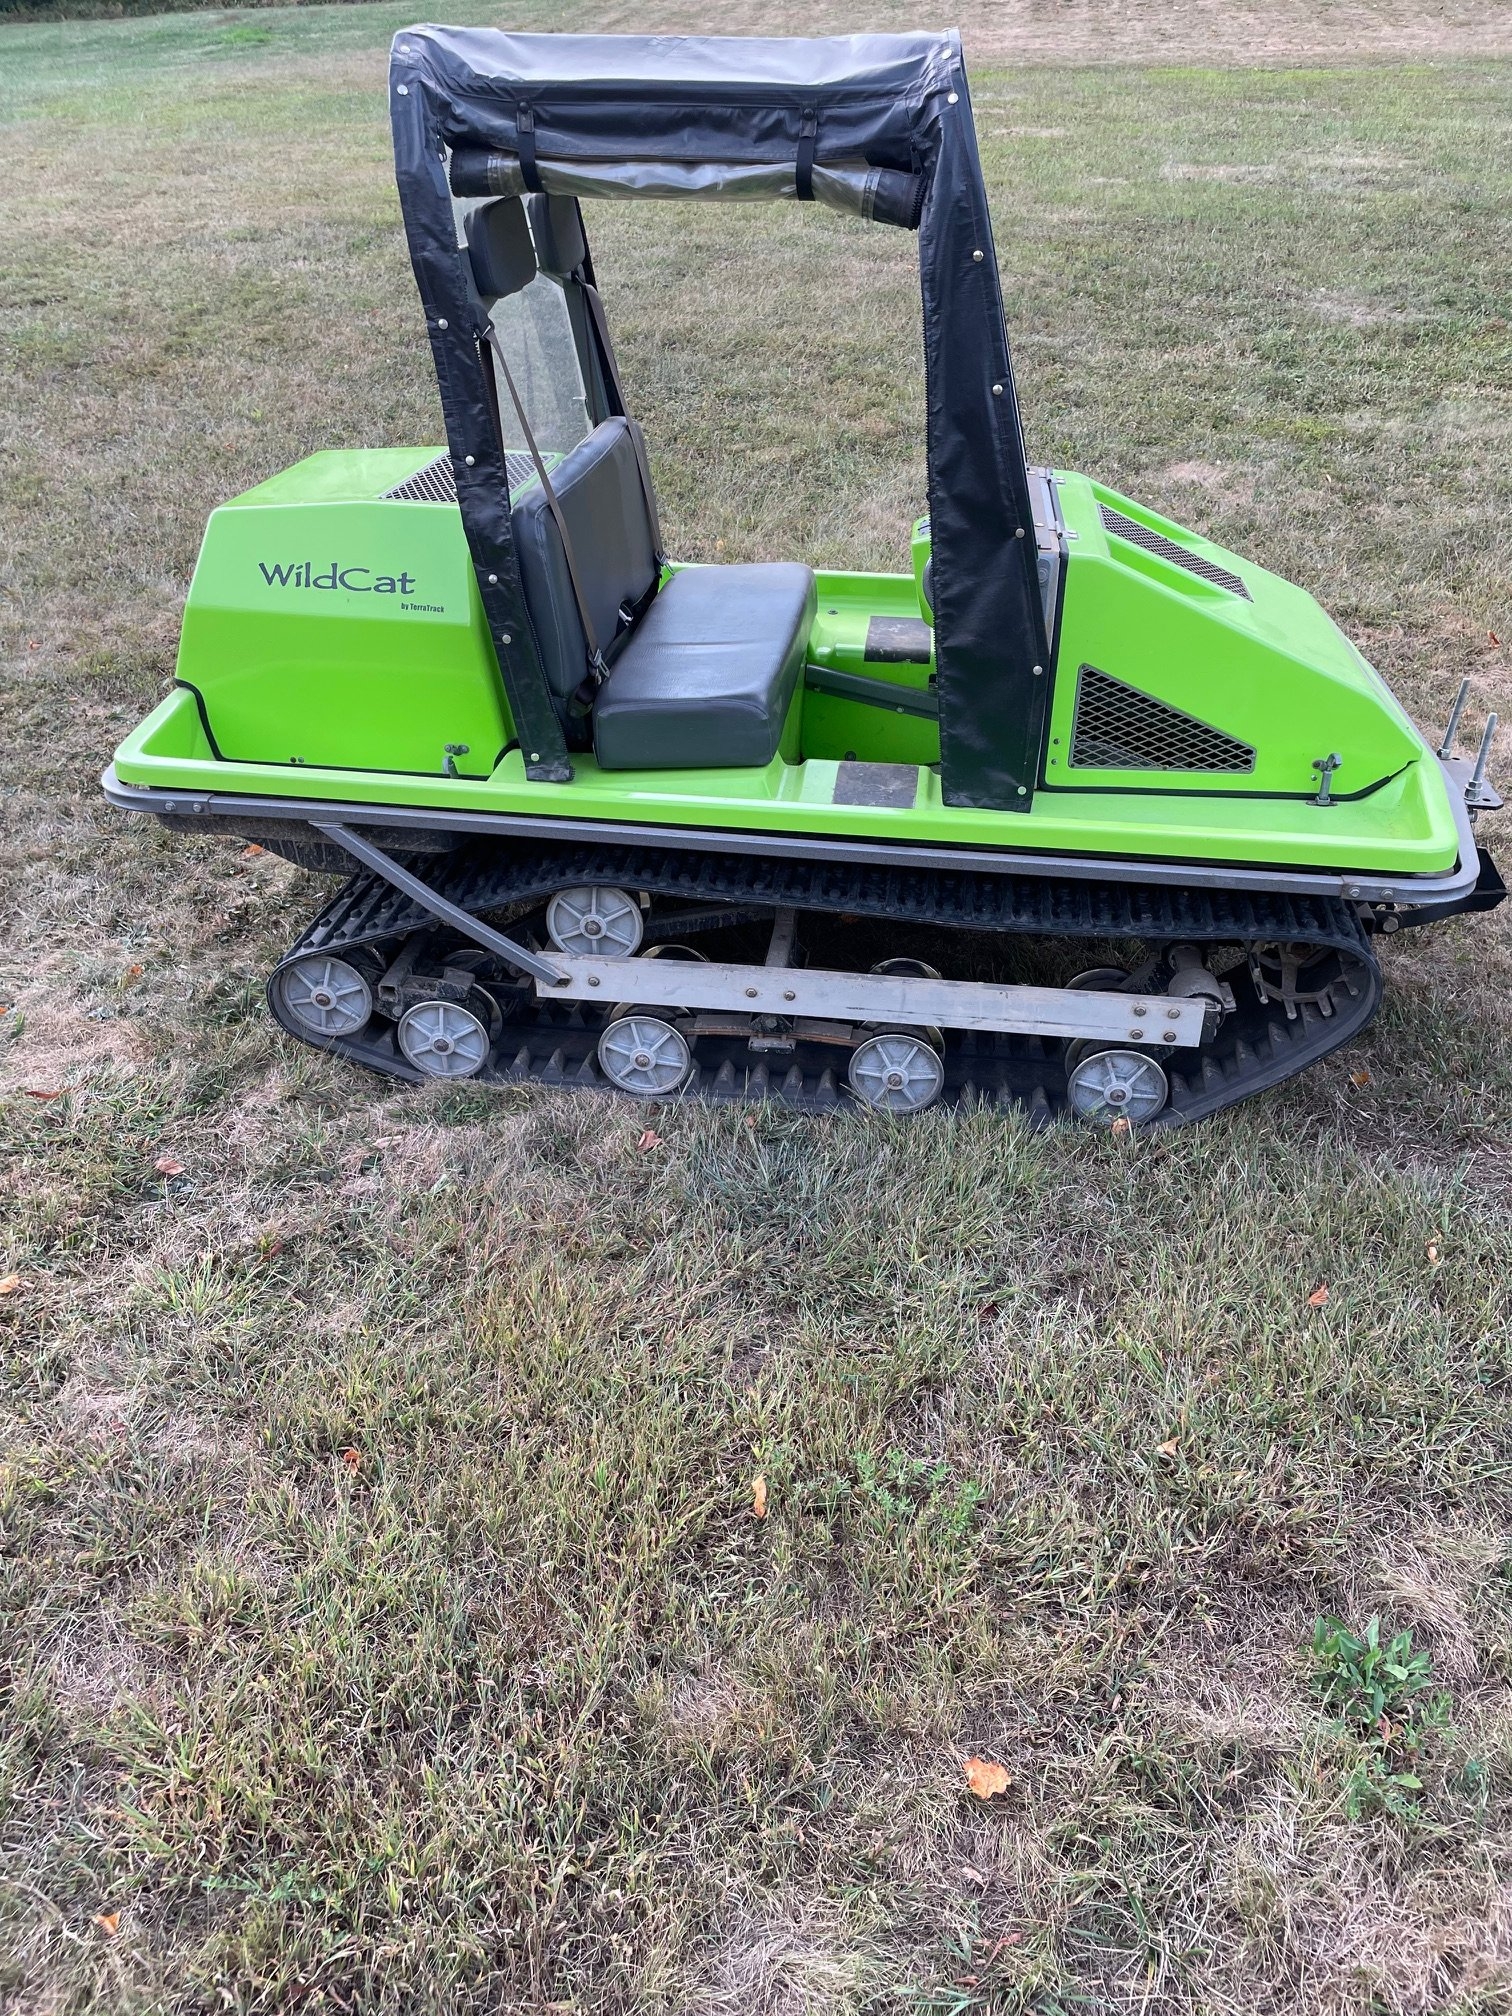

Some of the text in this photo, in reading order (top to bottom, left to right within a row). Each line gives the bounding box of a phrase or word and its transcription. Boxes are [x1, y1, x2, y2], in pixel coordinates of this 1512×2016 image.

[258, 561, 416, 595] WildCat
[401, 602, 444, 613] by TerraTrack
